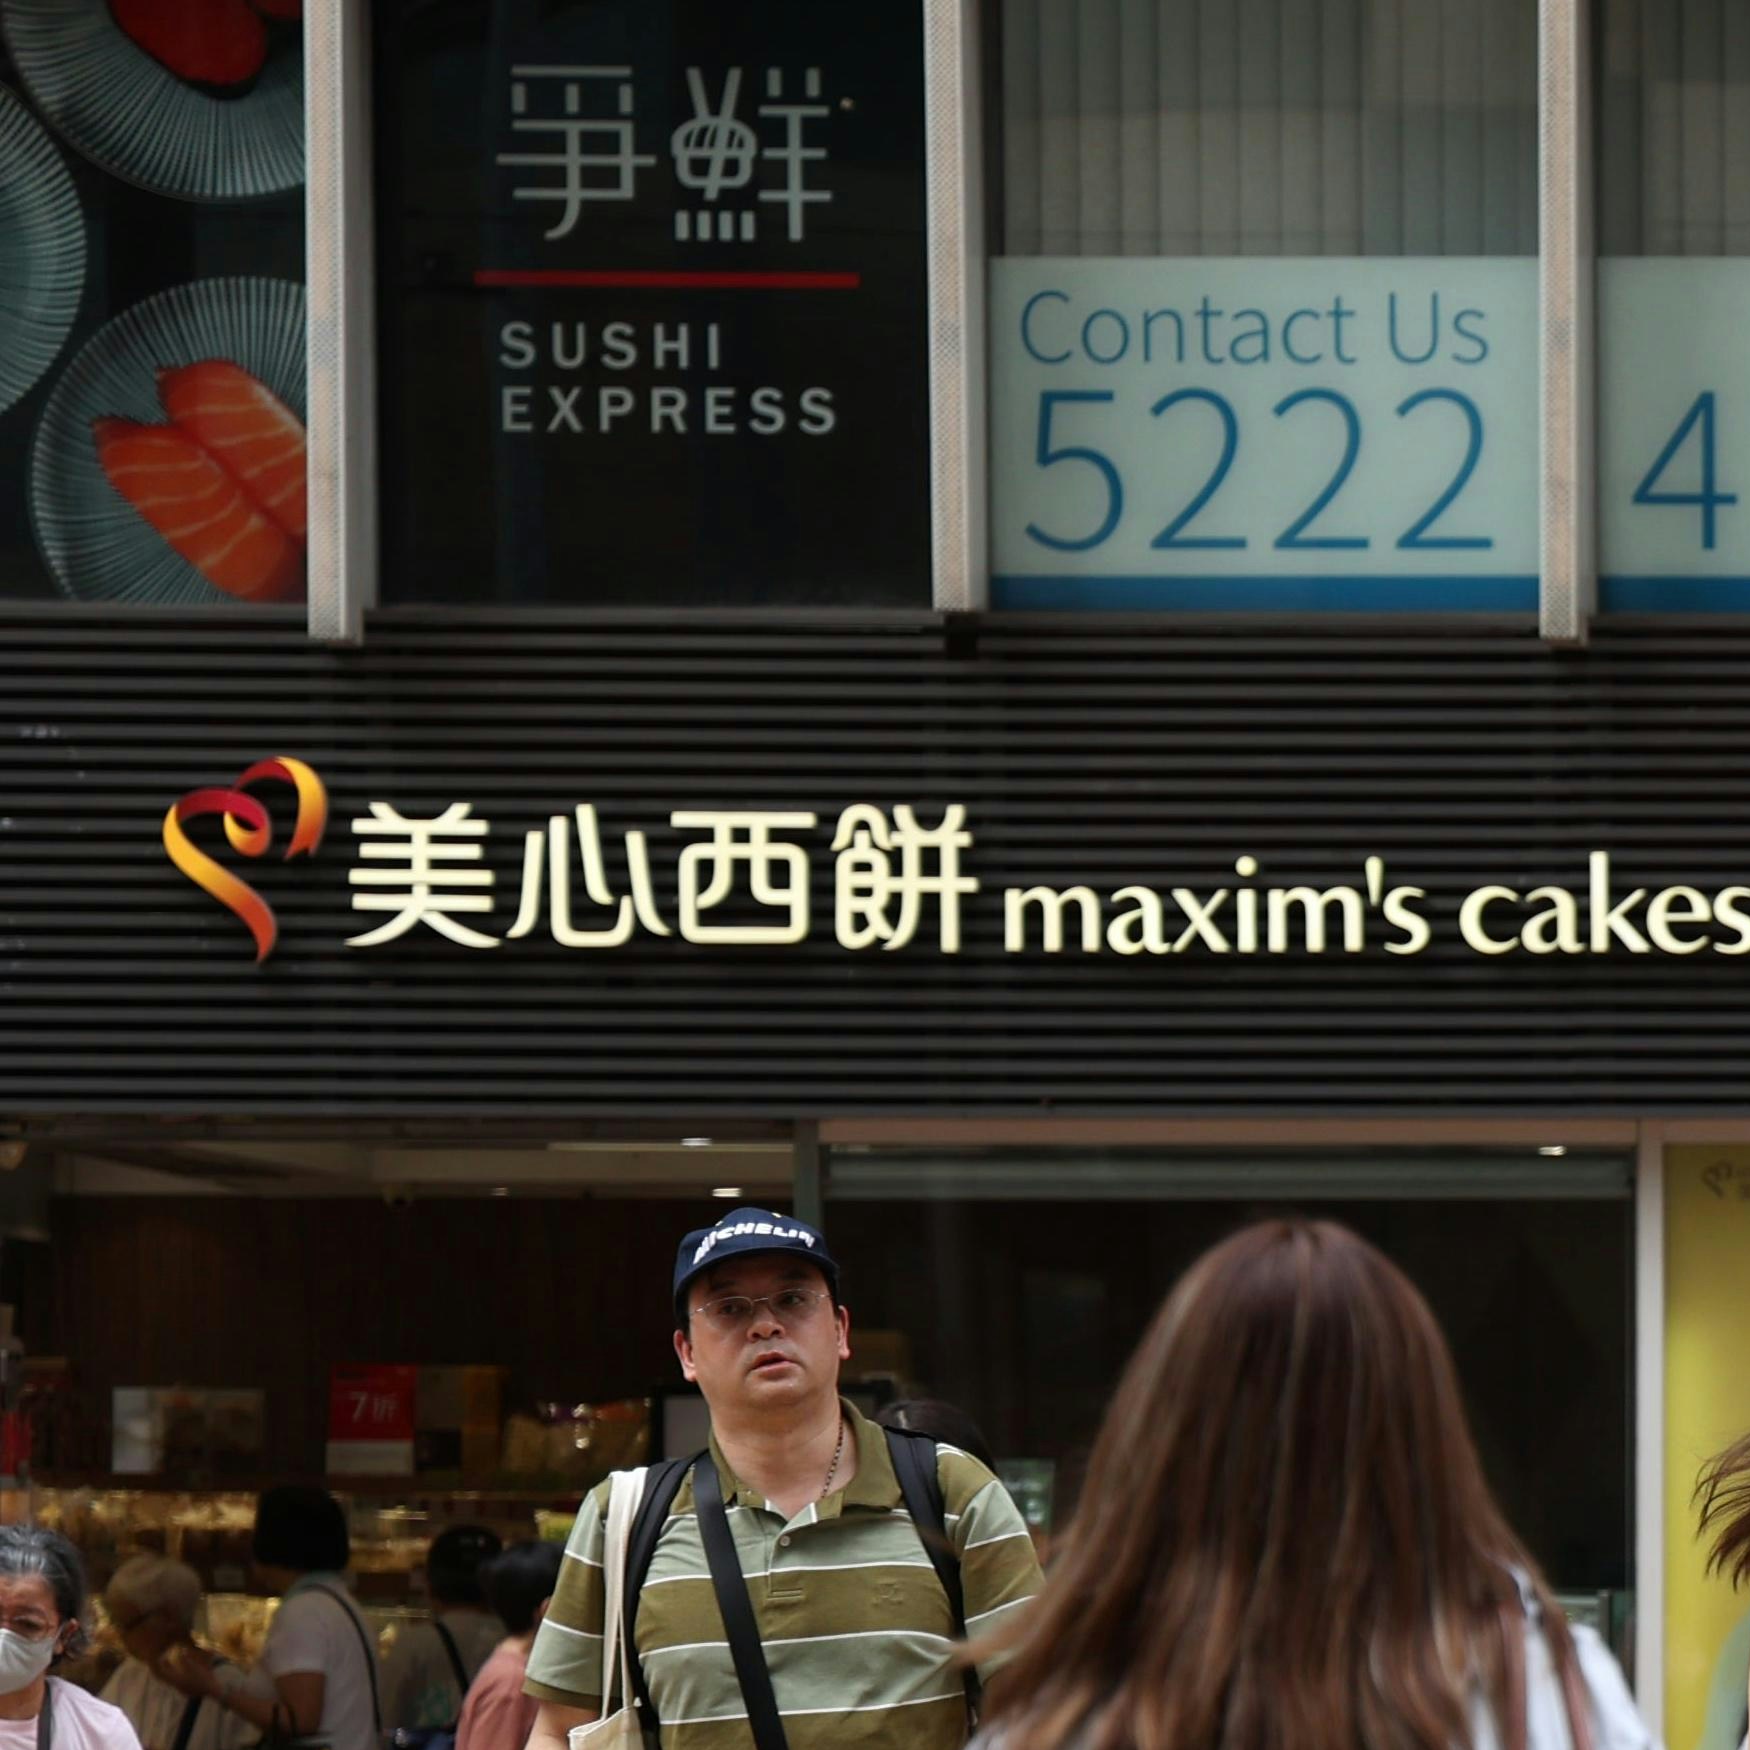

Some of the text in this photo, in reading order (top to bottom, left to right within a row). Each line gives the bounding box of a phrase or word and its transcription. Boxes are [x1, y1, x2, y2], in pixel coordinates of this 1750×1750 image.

[499, 321, 722, 370] SUSHI
[1019, 289, 1490, 368] Contact Us
[501, 386, 837, 435] EXPRESS
[1025, 387, 1494, 552] 5222
[344, 801, 982, 954] 美心西餅
[1002, 854, 1431, 956] maxim's
[692, 1221, 816, 1265] MICHELIN
